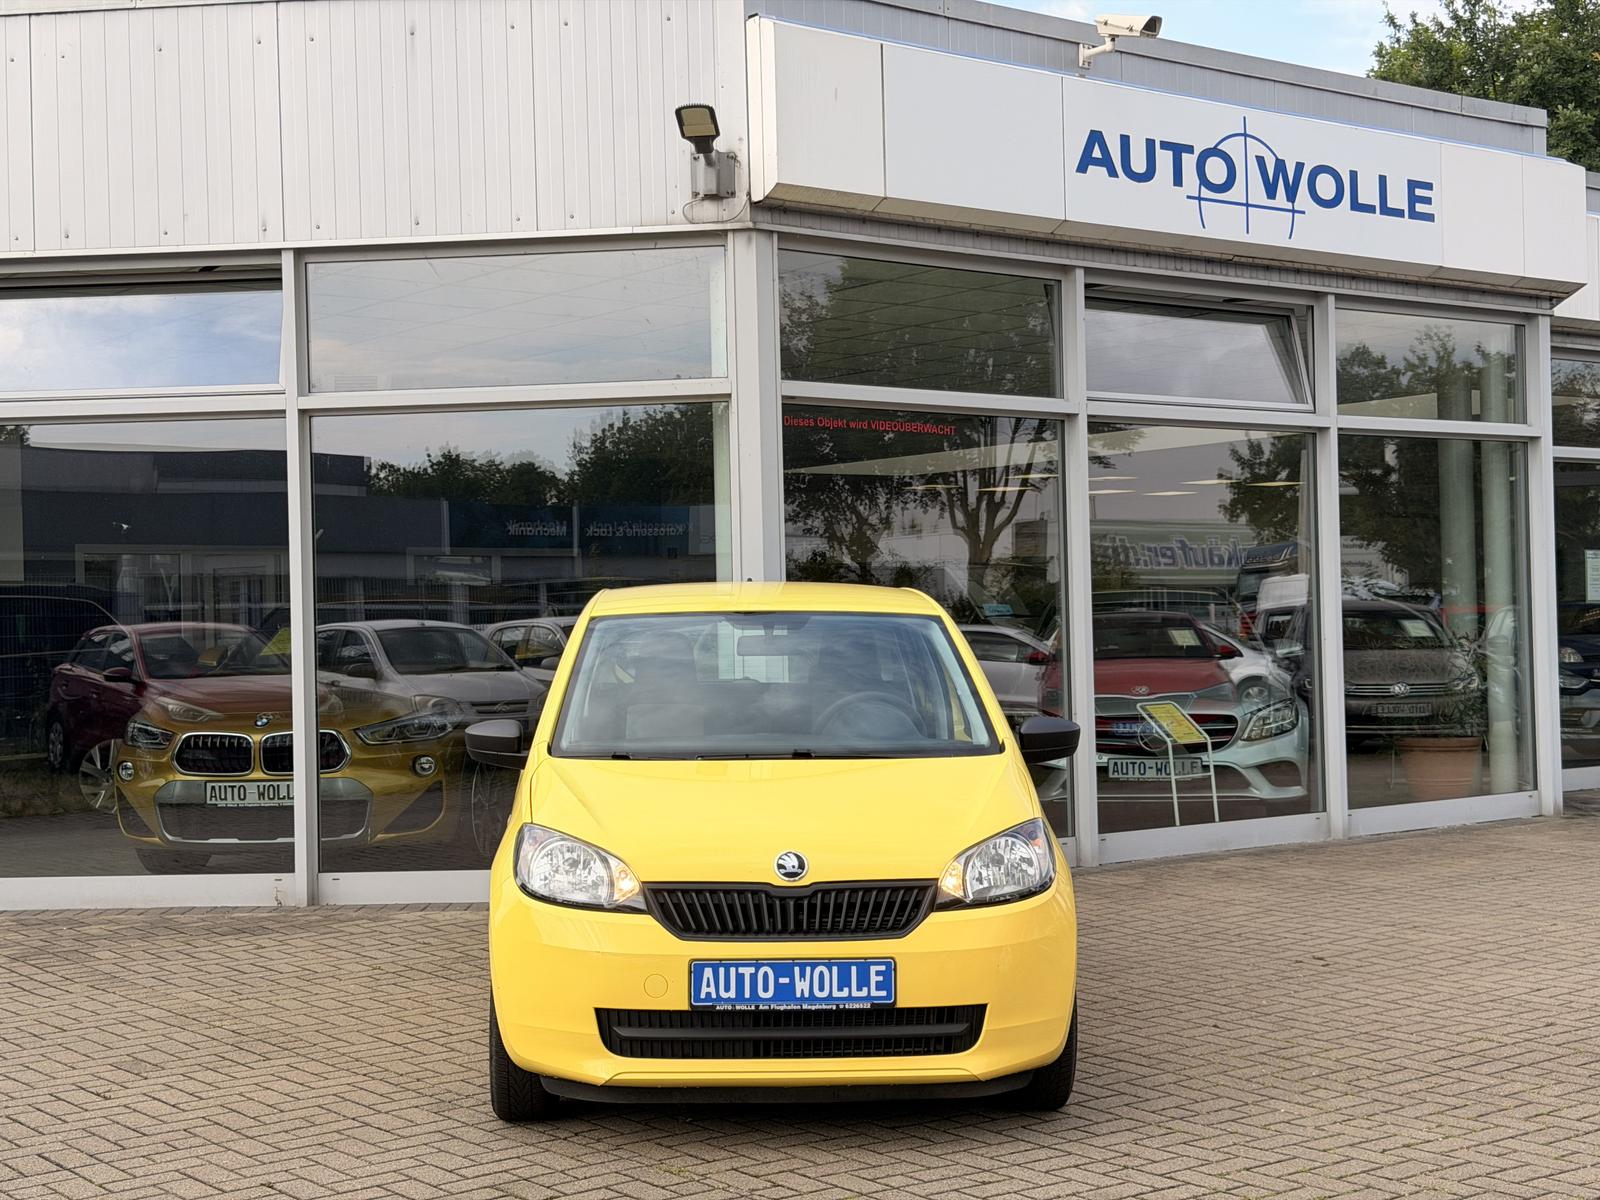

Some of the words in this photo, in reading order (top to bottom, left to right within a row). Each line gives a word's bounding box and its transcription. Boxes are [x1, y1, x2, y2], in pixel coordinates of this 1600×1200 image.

[1075, 130, 1237, 193] AUTO
[1254, 154, 1436, 223] WOLLE
[783, 416, 815, 427] Dieses
[817, 416, 847, 430] Objekt
[849, 418, 868, 430] wird
[209, 784, 294, 802] AUTO-WOLL
[700, 965, 887, 999] AUTO-WOLLE
